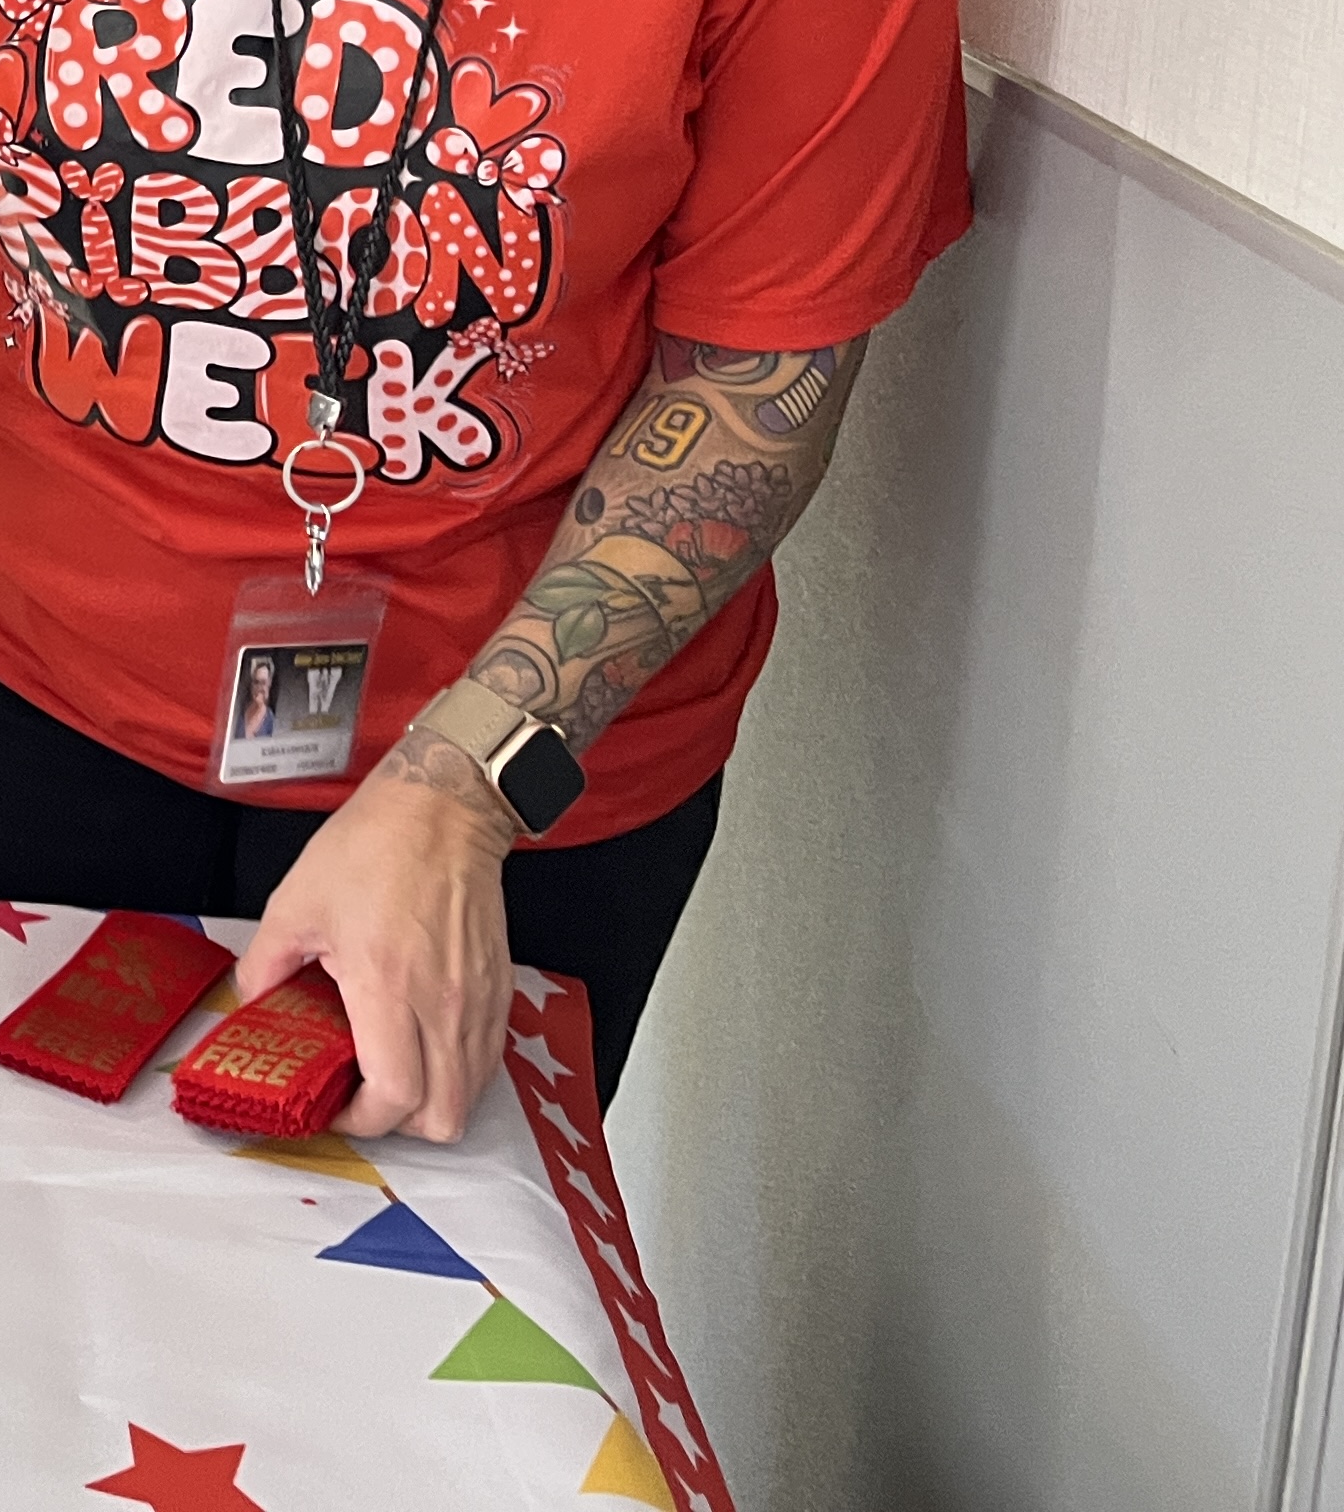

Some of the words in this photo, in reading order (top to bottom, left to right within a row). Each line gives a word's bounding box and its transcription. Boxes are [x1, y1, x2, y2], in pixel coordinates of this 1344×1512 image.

[32, 312, 496, 482] WEEK
[610, 394, 712, 472] 19
[191, 1043, 306, 1088] FREE
[215, 1024, 327, 1060] DRUG
